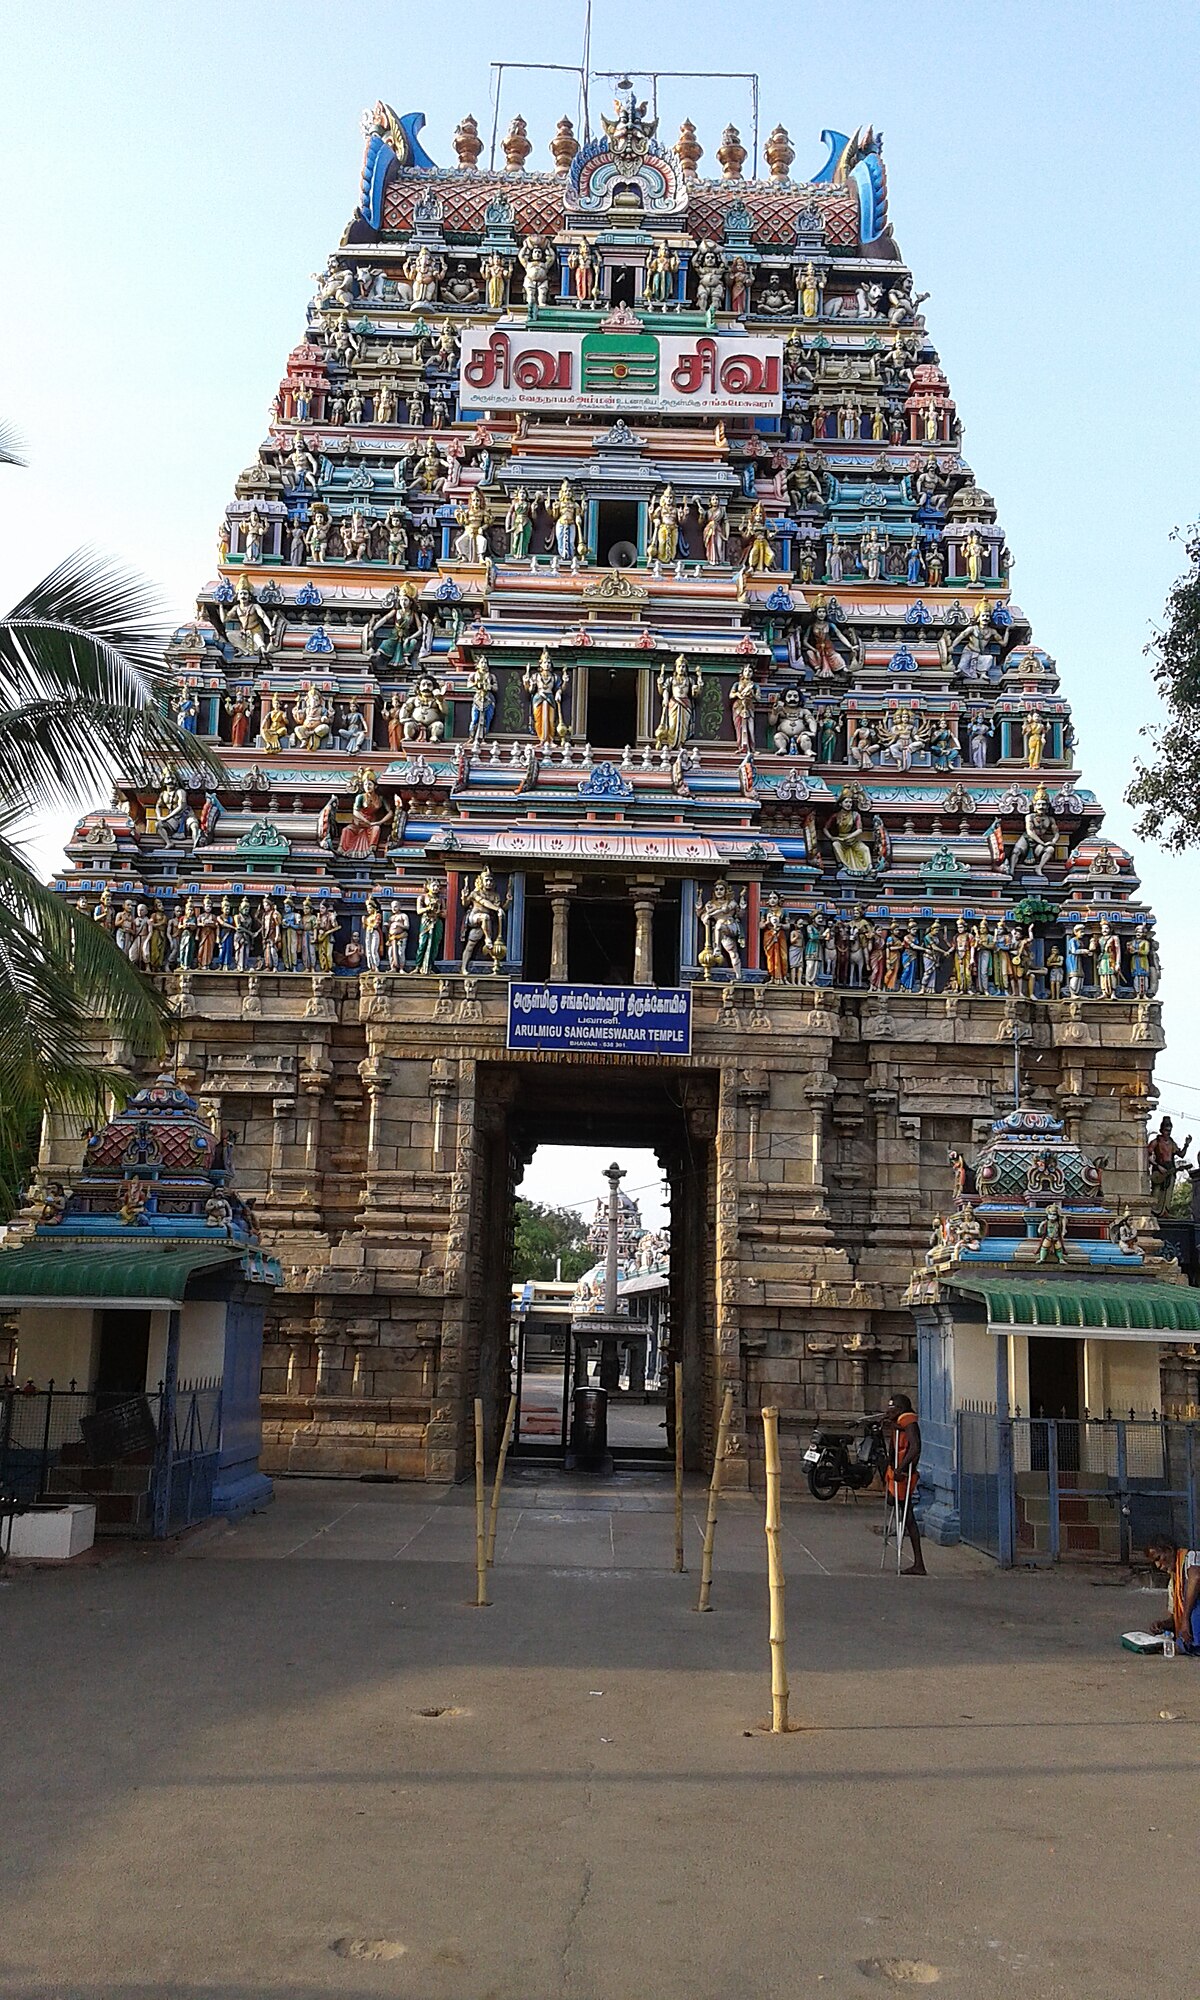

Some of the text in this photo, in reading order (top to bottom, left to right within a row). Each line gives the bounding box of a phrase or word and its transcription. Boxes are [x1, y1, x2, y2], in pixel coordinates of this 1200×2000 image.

[464, 332, 780, 394] சிவ சிவ
[513, 989, 687, 1017] அருள்மிகு சங்கமேஸ்வரர் திருக்கோயில்
[514, 1024, 684, 1042] ARULMIGU SANGAMESWARAR TEMPLE
[569, 1040, 598, 1048] BHAVANI
